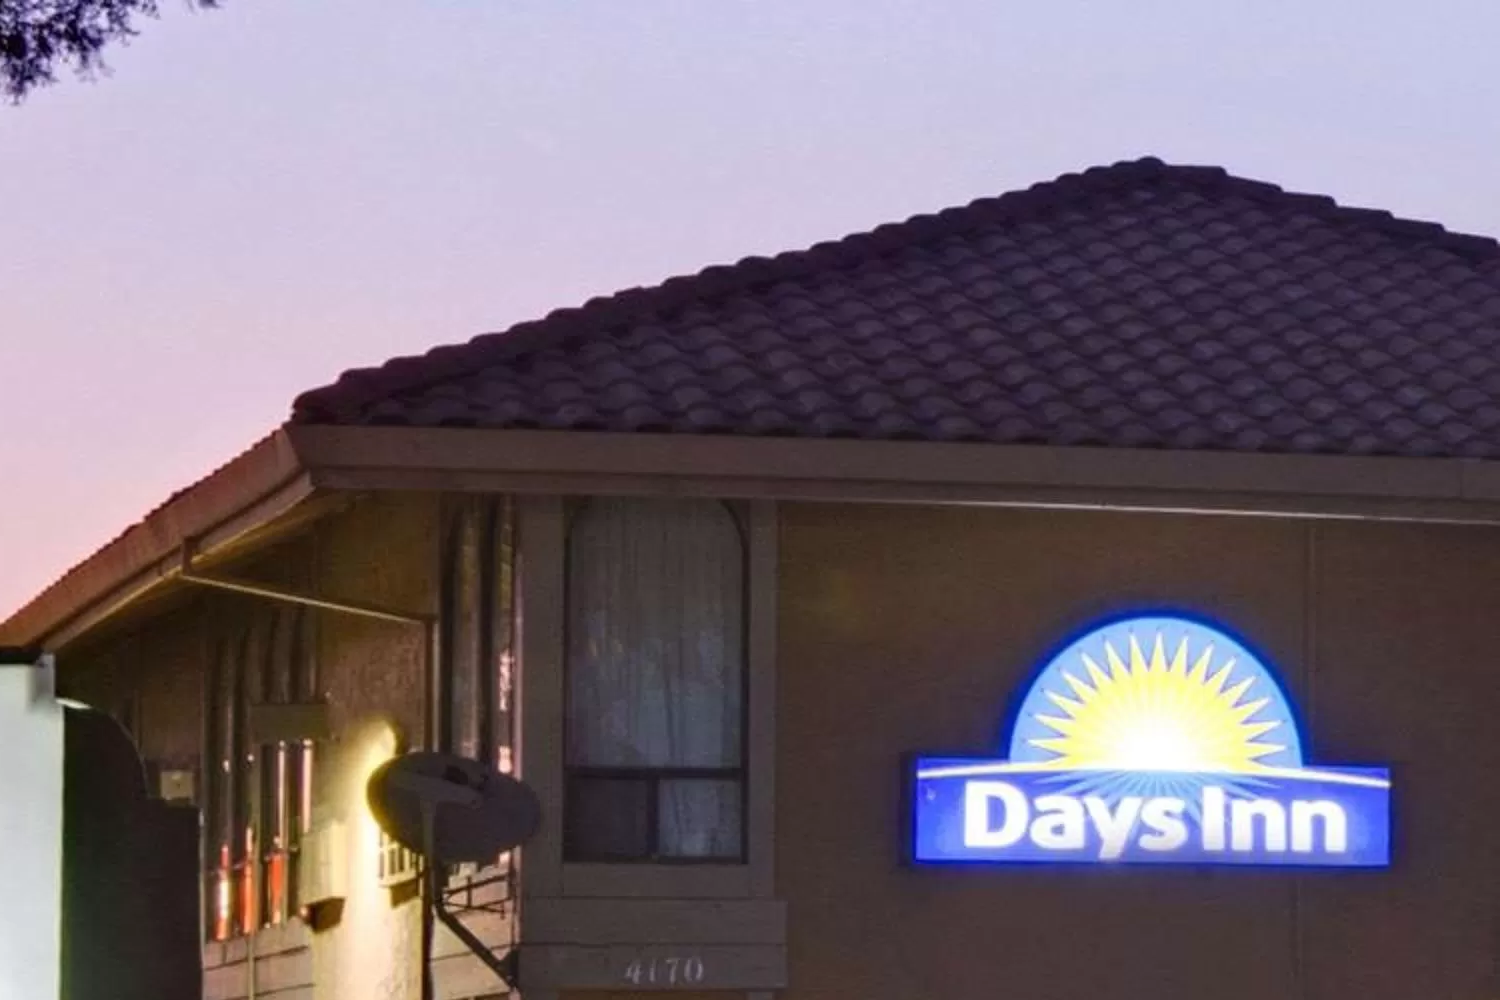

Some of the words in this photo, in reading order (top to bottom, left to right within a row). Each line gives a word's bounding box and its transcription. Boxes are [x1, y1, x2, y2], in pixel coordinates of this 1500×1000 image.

[963, 780, 1188, 859] Days
[1202, 786, 1347, 852] Inn
[624, 956, 704, 987] 4170
